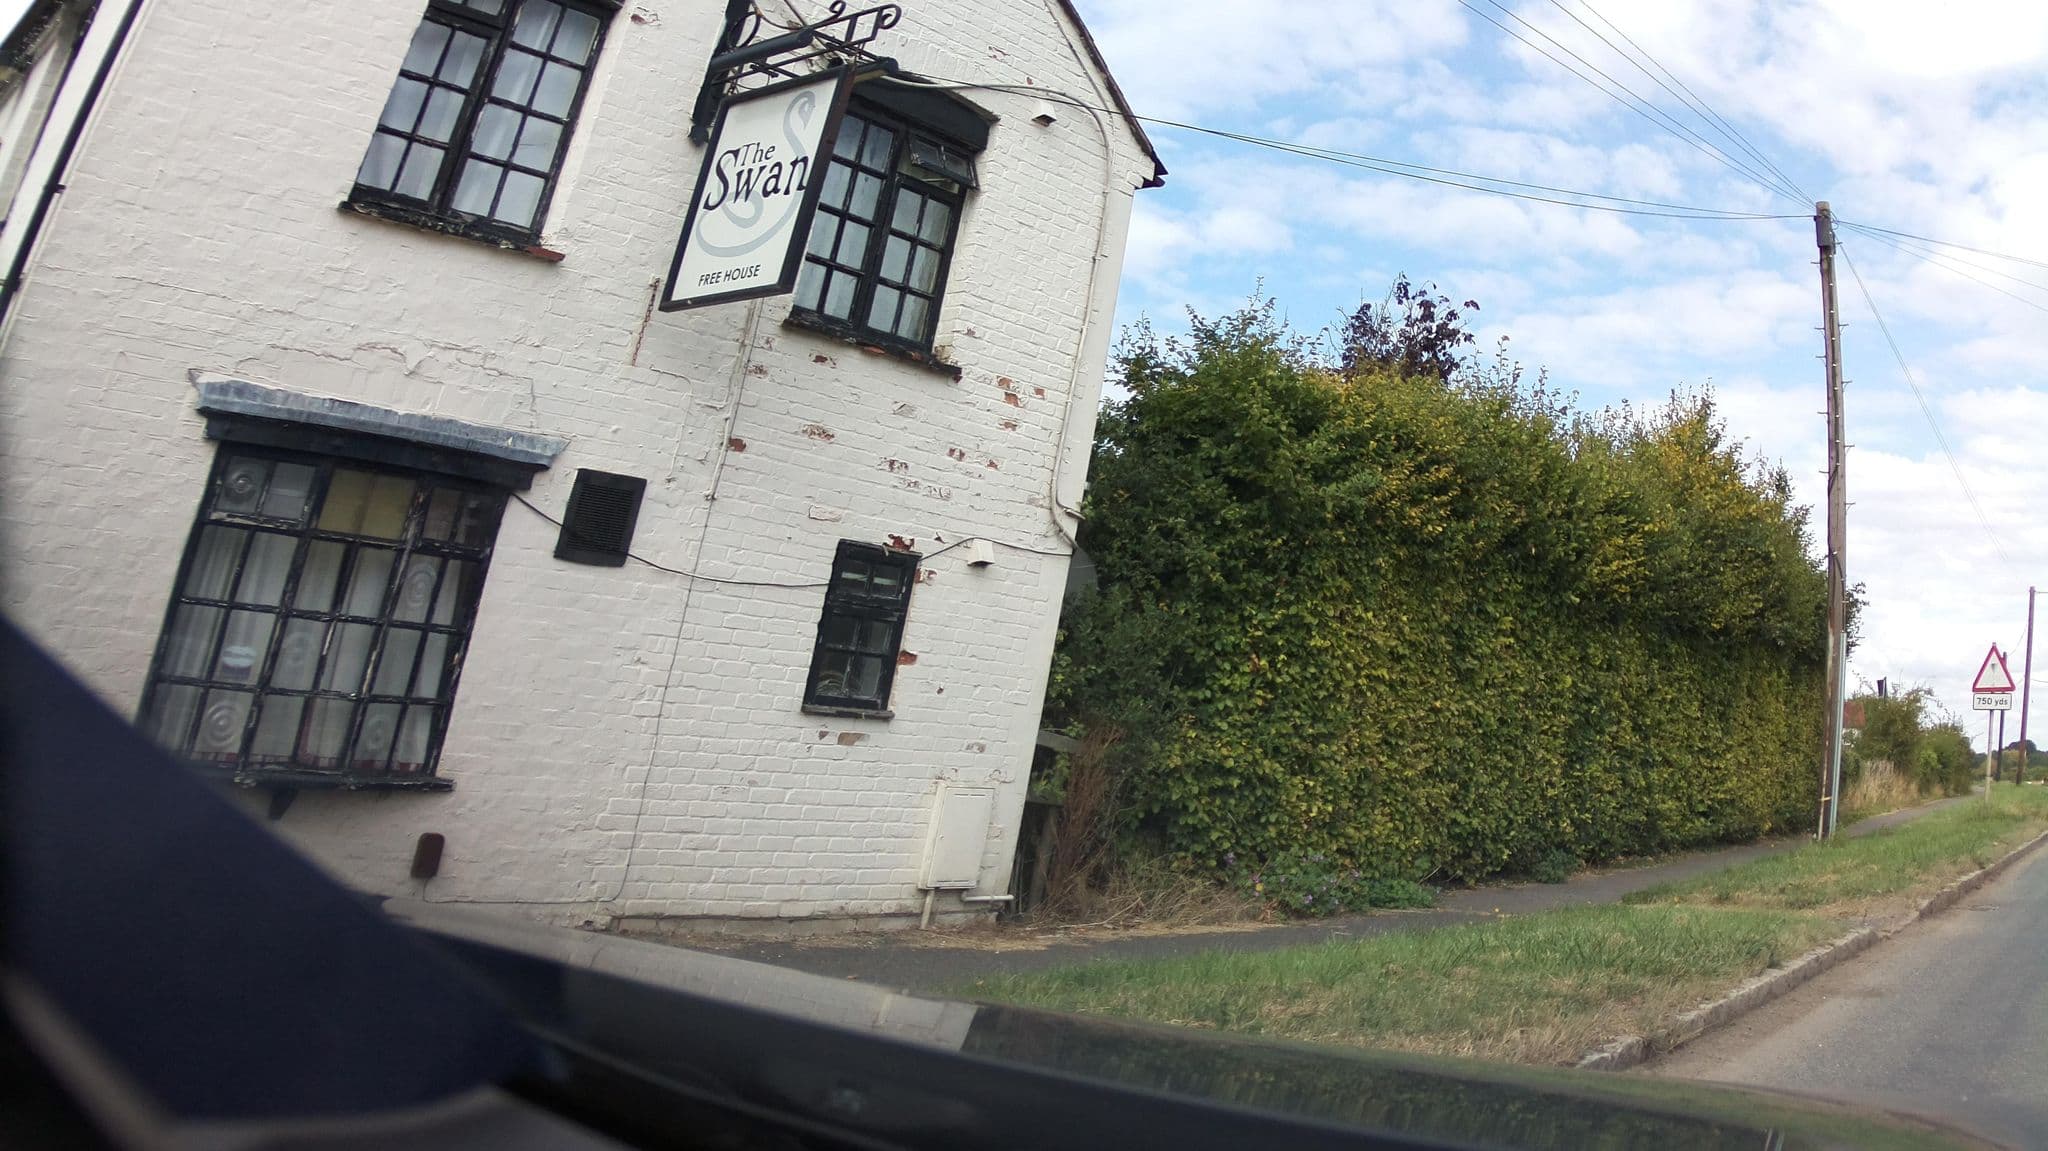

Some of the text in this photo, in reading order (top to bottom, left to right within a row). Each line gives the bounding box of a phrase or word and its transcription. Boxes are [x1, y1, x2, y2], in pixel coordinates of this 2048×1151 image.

[740, 142, 776, 167] The
[703, 147, 809, 211] Swan
[698, 264, 761, 287] FREE HOUSE
[1976, 697, 2008, 706] 750 yds
